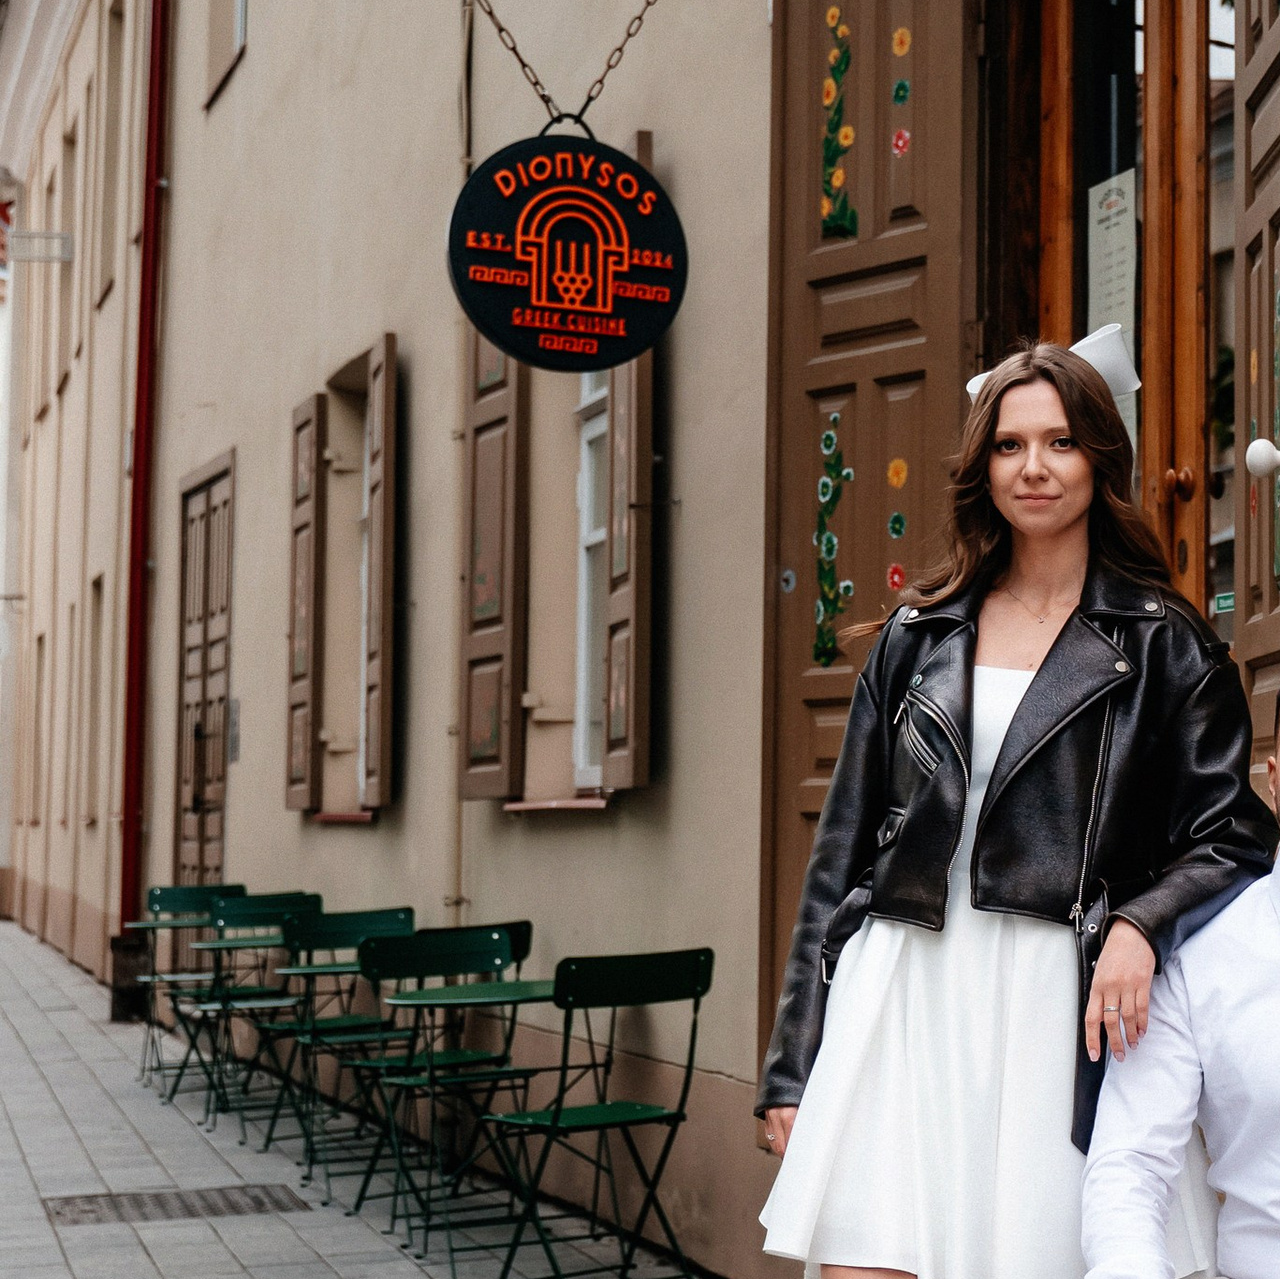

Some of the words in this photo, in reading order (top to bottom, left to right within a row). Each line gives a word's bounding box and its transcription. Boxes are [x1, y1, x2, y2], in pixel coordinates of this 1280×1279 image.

[465, 230, 512, 252] EST.
[511, 307, 562, 332] GREEK
[567, 315, 627, 337] CUISINE
